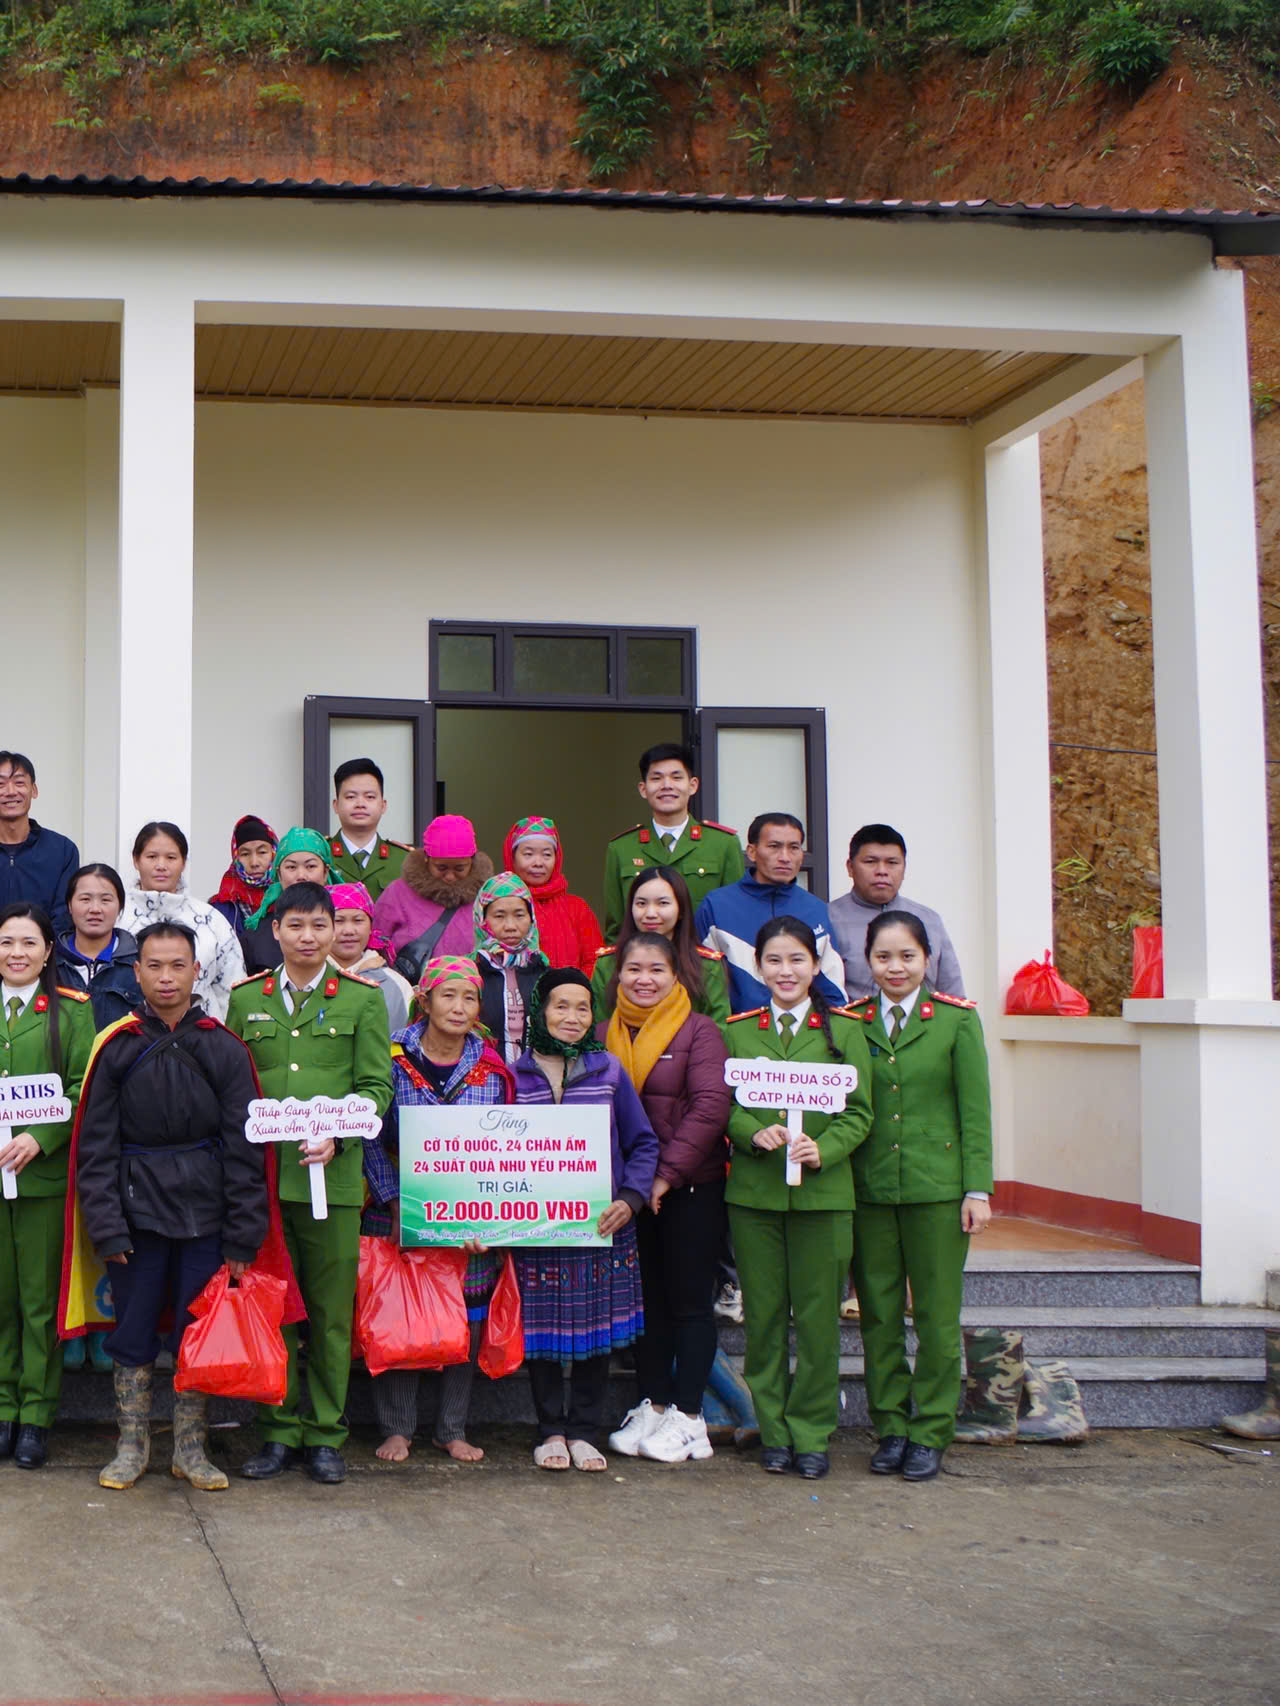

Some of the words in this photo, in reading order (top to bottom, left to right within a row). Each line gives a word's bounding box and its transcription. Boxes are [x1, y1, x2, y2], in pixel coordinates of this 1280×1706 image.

[730, 1070, 761, 1084] CỤM
[765, 1072, 785, 1083] THI
[790, 1074, 818, 1085] ĐUA
[822, 1072, 841, 1086] SỐ
[845, 1077, 853, 1087] 2
[347, 1101, 368, 1114] Cao
[748, 1092, 783, 1103] CATP
[787, 1091, 805, 1105] HÀ
[809, 1092, 833, 1109] NỘI
[16, 1105, 64, 1120] NGUYÊN
[479, 1109, 530, 1136] Tặng
[423, 1137, 441, 1152] CỜ
[445, 1135, 461, 1152] TỔ
[464, 1135, 502, 1153] QUỐC,
[506, 1139, 522, 1152] 24
[526, 1138, 561, 1152] CHĂN
[565, 1135, 586, 1152] ẤM
[414, 1160, 429, 1173] 24
[433, 1157, 466, 1173] SUẤT
[470, 1157, 495, 1174] QUÀ
[499, 1160, 526, 1172] NHU
[530, 1156, 554, 1172] YẾU
[559, 1155, 597, 1172] PHẨM
[477, 1181, 499, 1196] TRỊ
[503, 1178, 533, 1193] GIÁ:
[423, 1201, 539, 1221] 12.000.000
[546, 1201, 589, 1221] VNĐ
